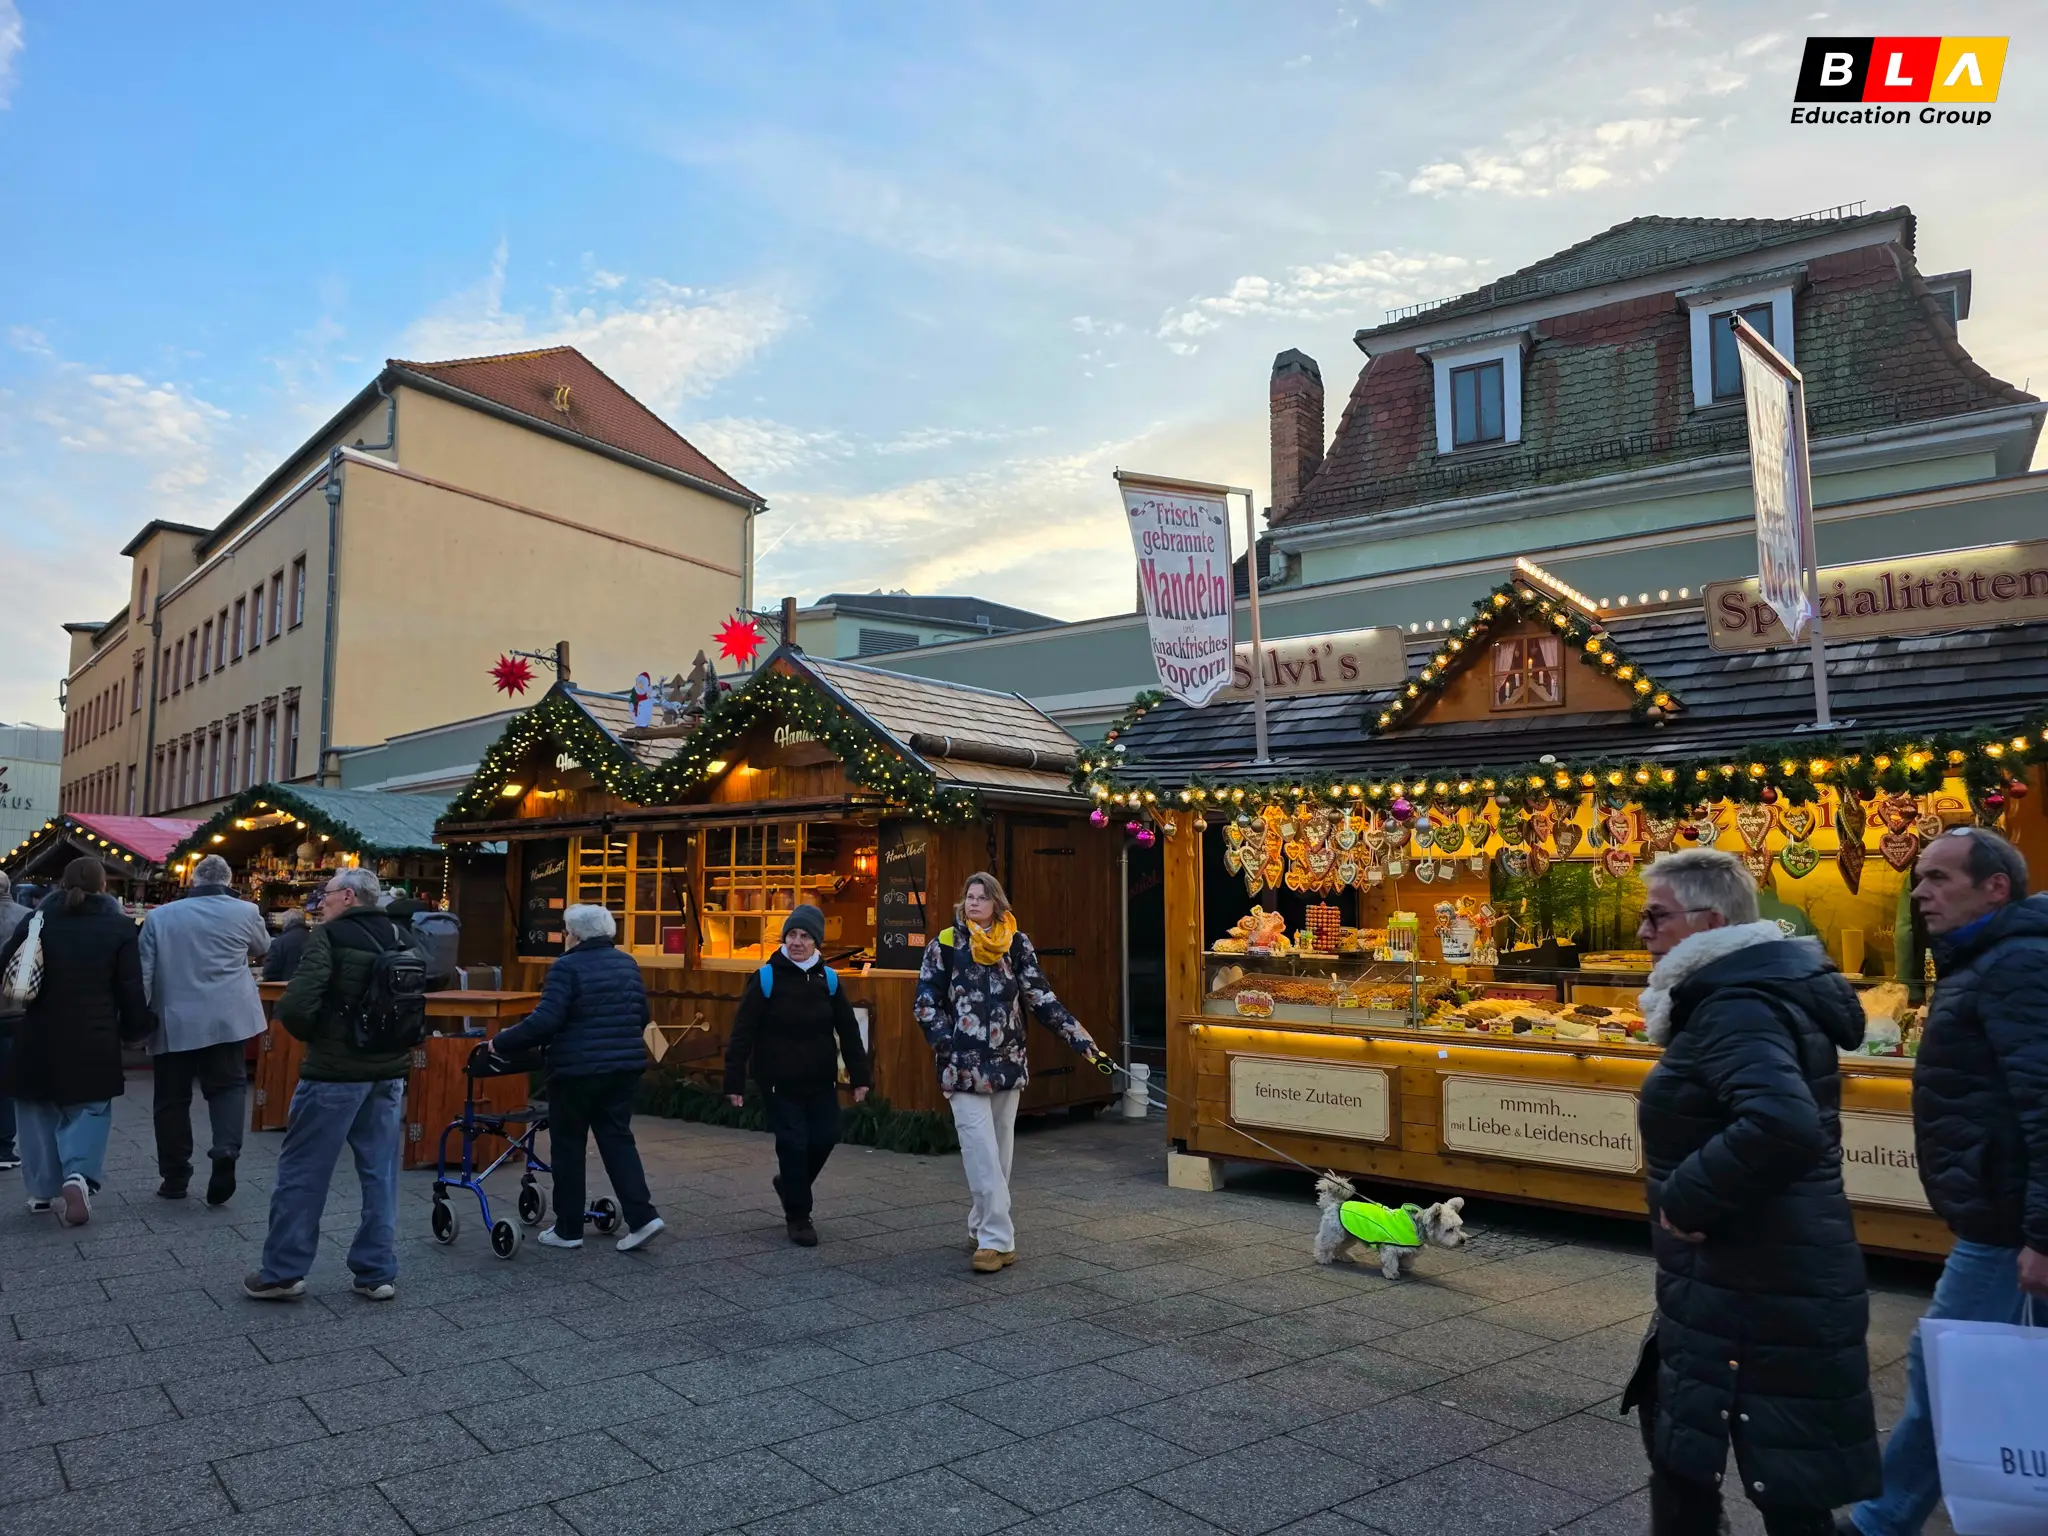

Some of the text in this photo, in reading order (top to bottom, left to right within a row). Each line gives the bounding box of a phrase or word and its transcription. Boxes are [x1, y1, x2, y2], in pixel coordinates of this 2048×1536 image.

[1156, 502, 1199, 528] Frisch
[1142, 525, 1215, 555] gebrannte
[1139, 554, 1228, 620] Mandeln
[1182, 624, 1195, 633] und
[1151, 635, 1228, 660] Knackfrisches
[1156, 656, 1226, 694] Popcorn
[1255, 1082, 1363, 1108] feinste Zutaten
[1500, 1098, 1577, 1118] mmmh...
[1450, 1116, 1634, 1151] mit Liebe & Leidenschaft
[1840, 1145, 1918, 1169] ualität
